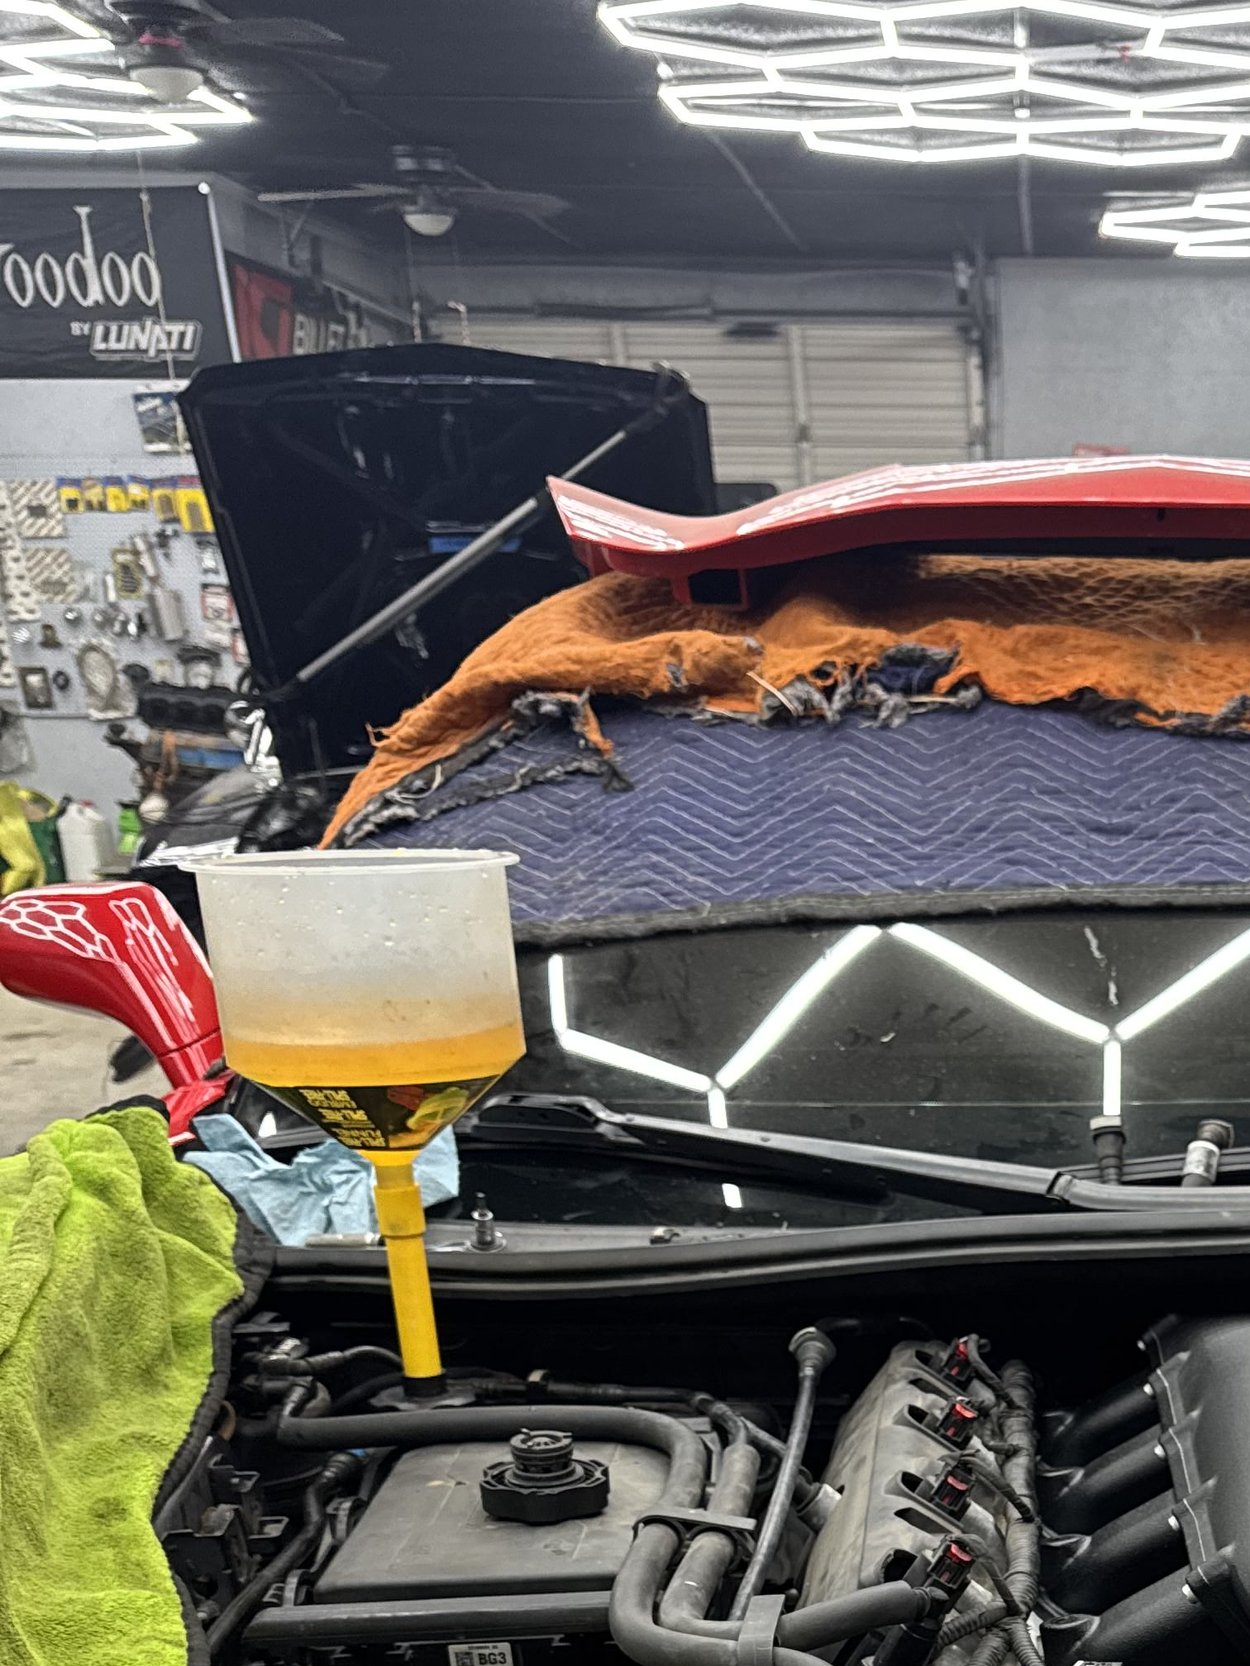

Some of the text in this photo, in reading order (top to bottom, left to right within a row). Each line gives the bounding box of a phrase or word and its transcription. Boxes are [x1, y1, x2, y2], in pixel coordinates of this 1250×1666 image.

[0, 205, 160, 308] oodoo
[70, 320, 196, 358] BY LUNATI
[477, 1651, 508, 1666] BG3
